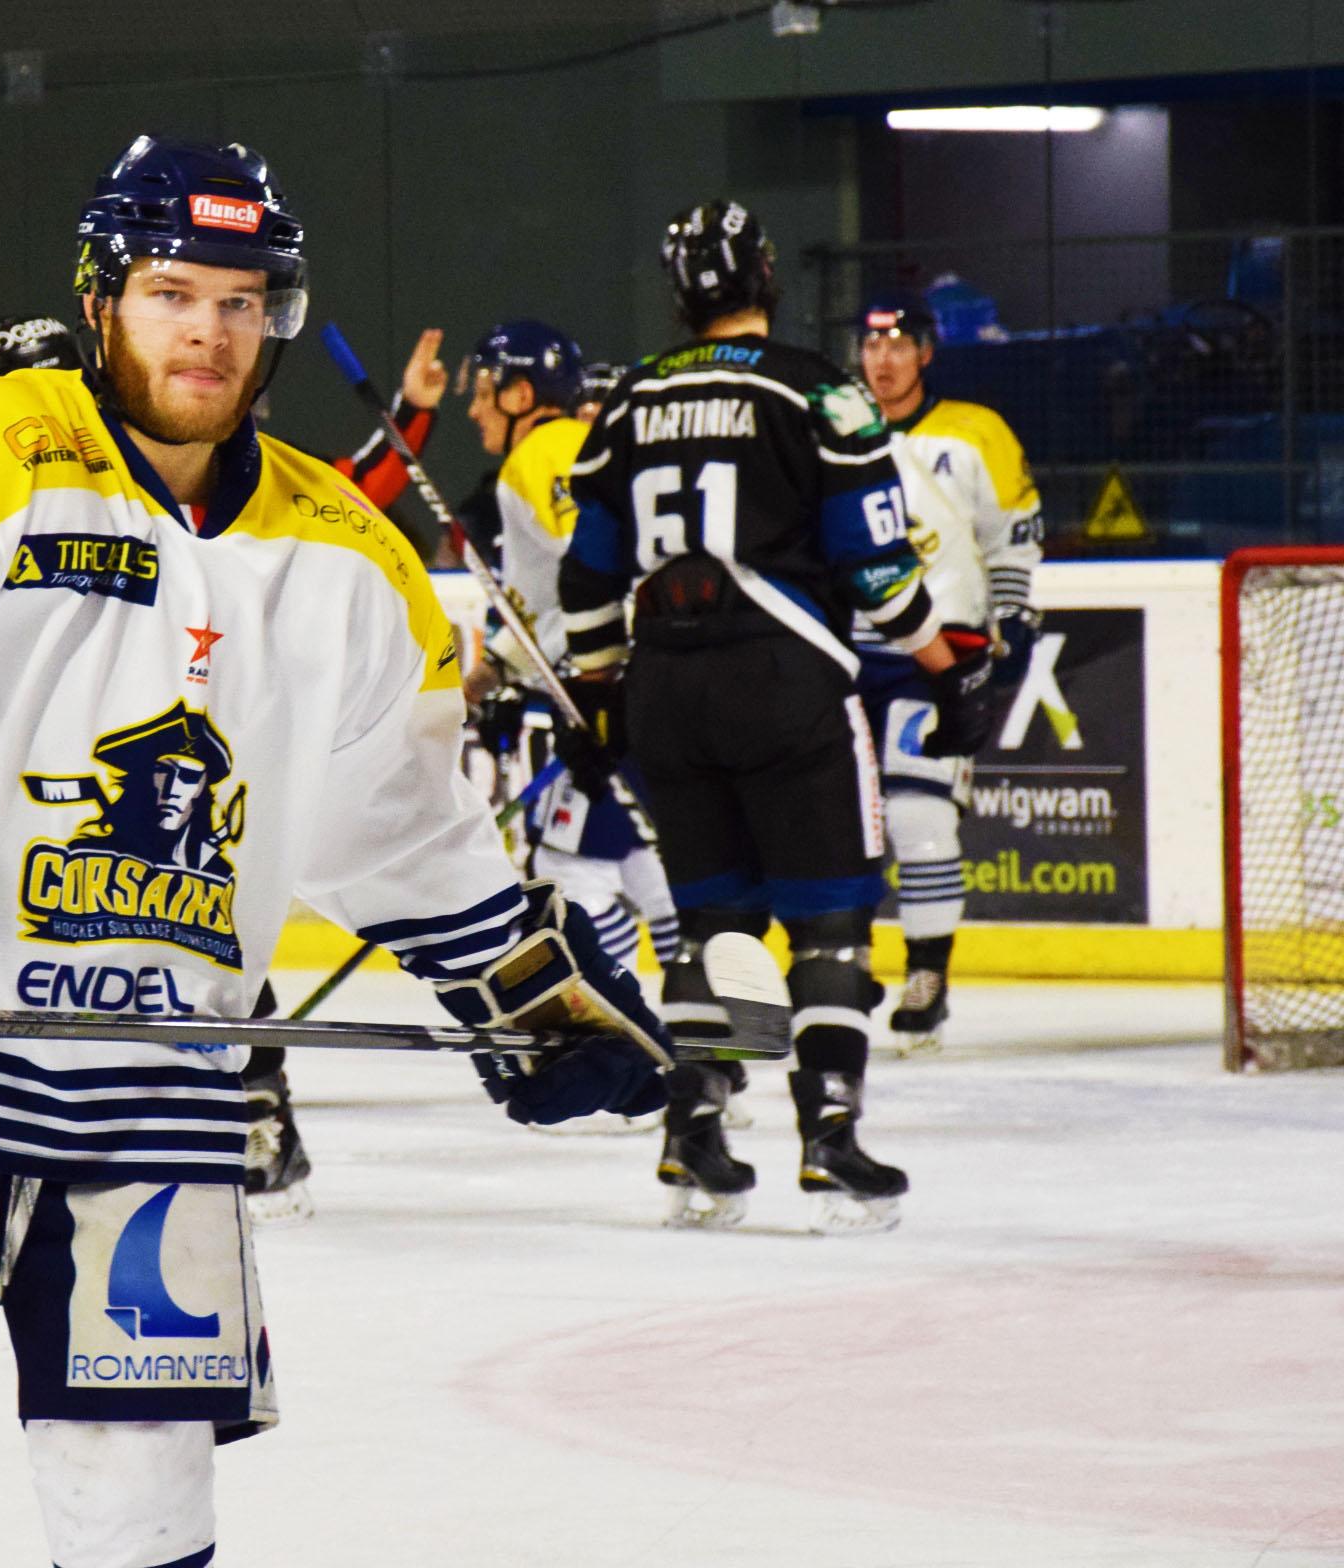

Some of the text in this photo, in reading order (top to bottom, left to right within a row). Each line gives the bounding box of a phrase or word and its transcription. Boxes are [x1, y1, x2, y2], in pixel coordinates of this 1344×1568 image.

[193, 197, 257, 223] flunch
[932, 451, 953, 476] A
[630, 461, 737, 572] 61
[862, 485, 905, 547] 61
[52, 919, 104, 939] HOCKEY
[16, 960, 195, 1014] ENDEL
[71, 1353, 248, 1382] ROMAN'EAU
